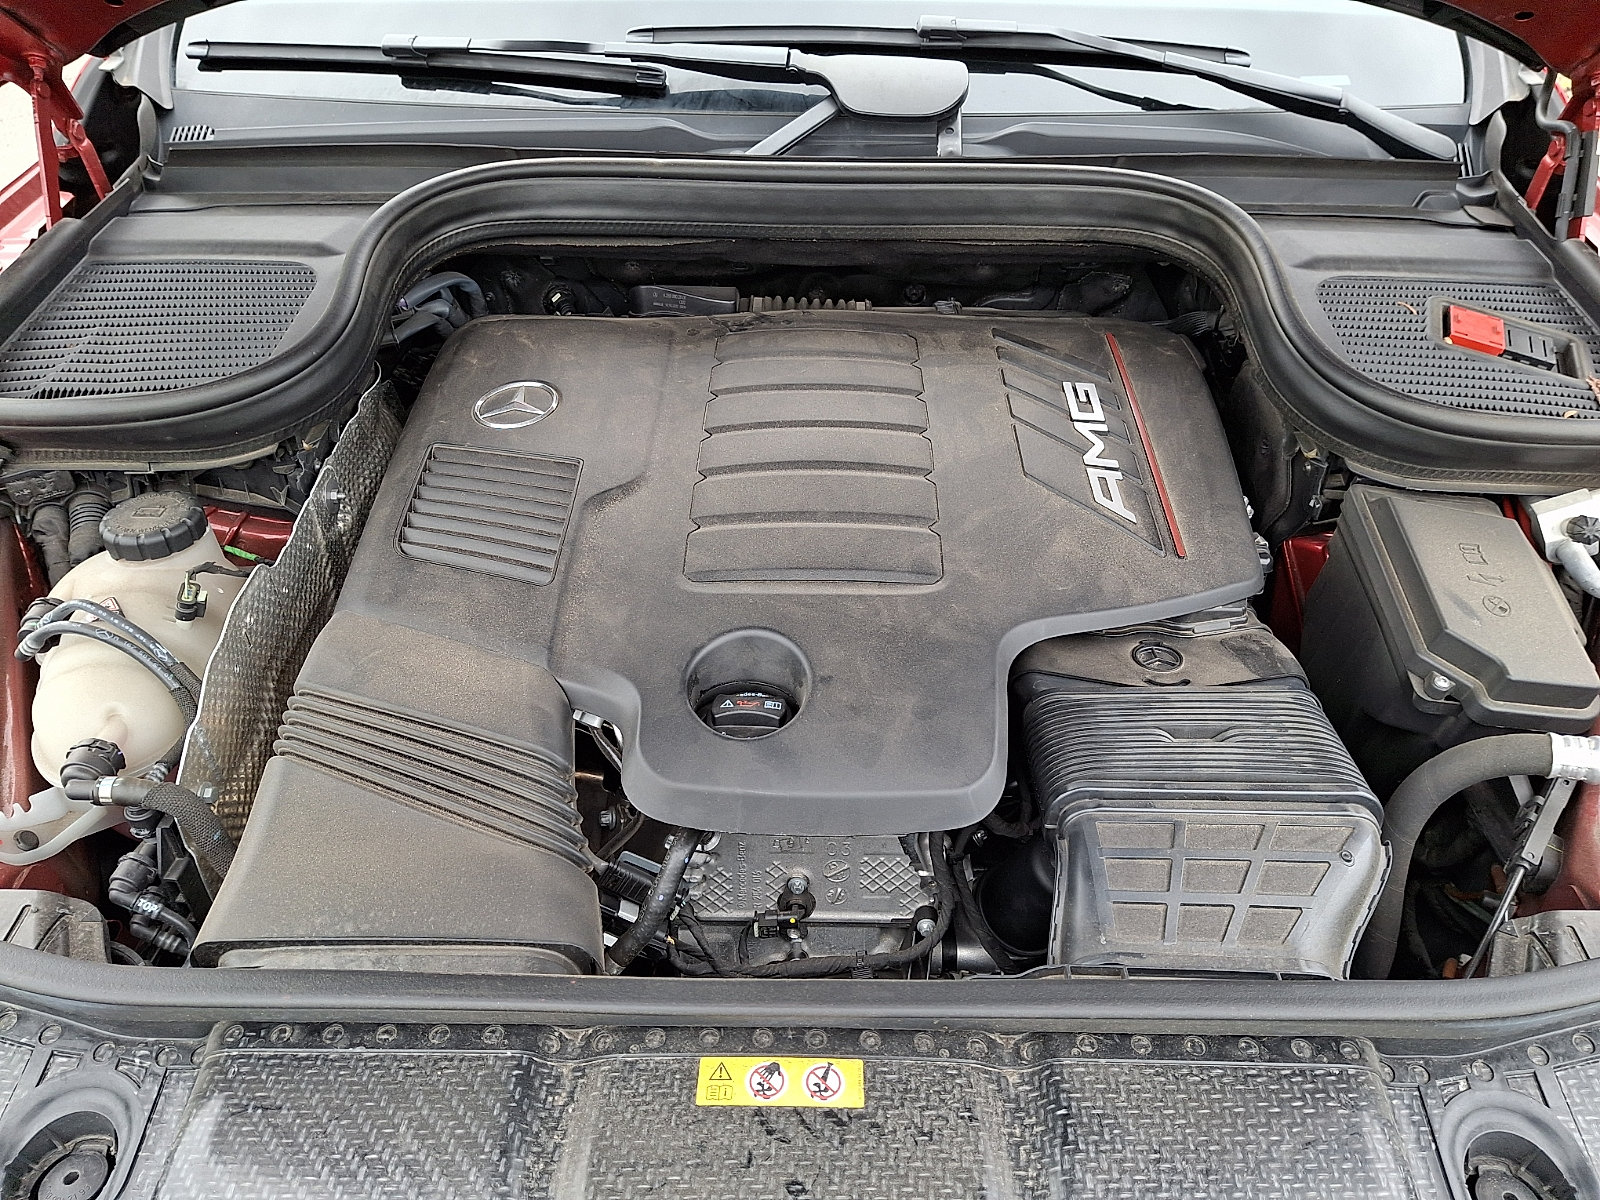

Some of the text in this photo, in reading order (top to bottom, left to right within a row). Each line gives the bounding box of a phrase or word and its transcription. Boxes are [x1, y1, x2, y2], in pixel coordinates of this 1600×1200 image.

[1062, 381, 1137, 524] AMG
[737, 841, 747, 900] Mercedes-Benz
[137, 898, 159, 913] TOP
